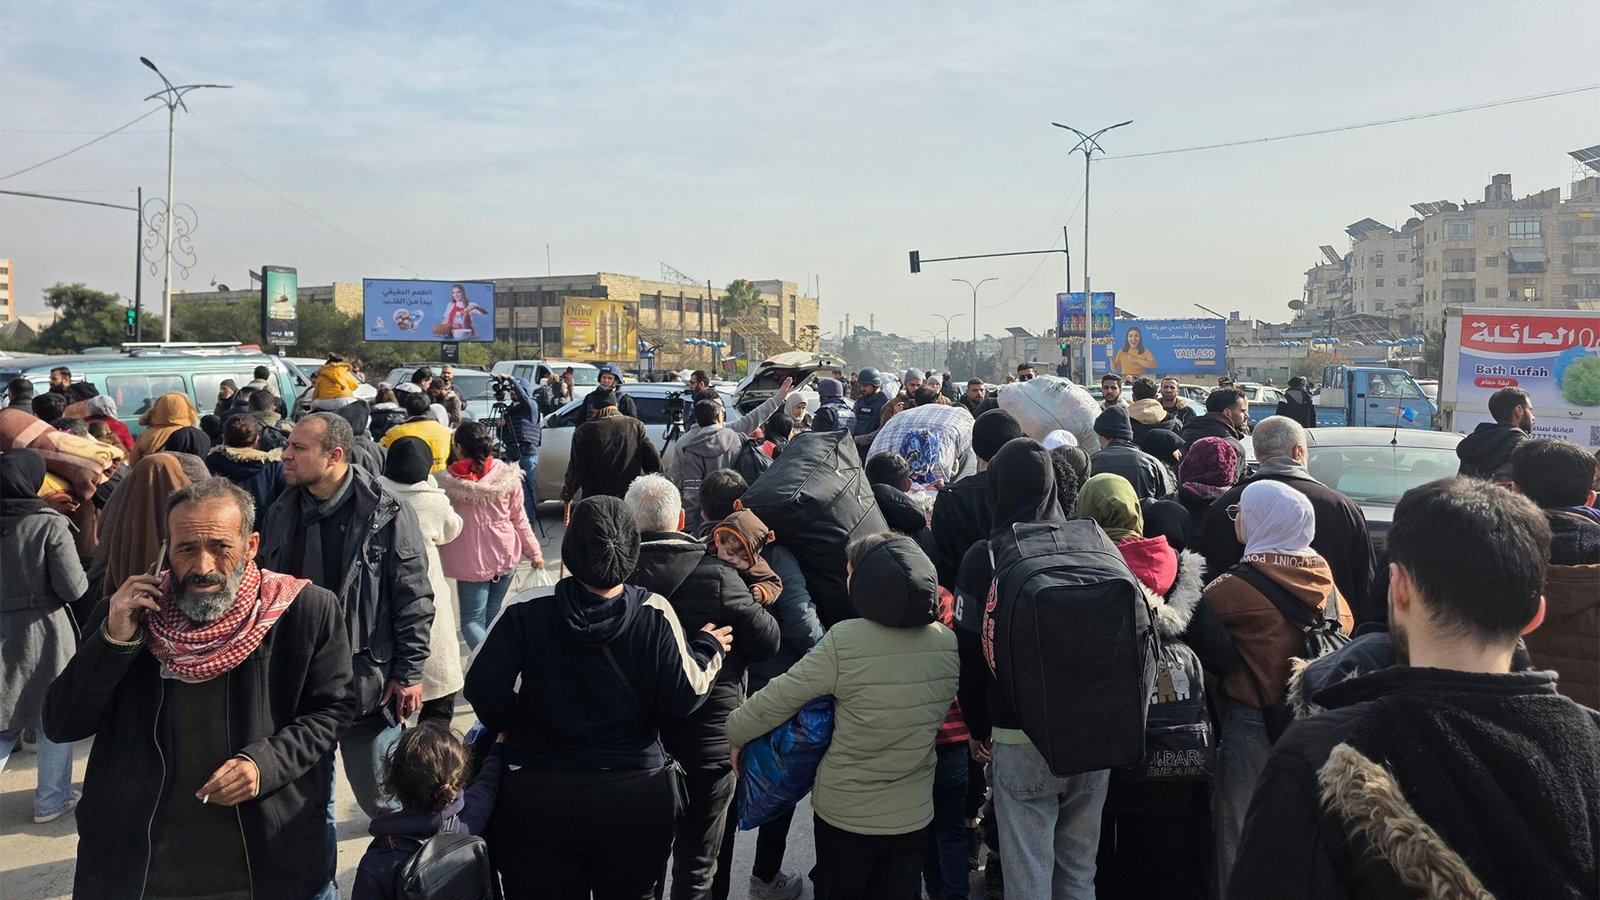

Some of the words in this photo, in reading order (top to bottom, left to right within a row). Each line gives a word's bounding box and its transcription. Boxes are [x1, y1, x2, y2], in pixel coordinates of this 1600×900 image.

[382, 287, 410, 297] الحقيقي
[411, 288, 433, 297] الطعم
[566, 303, 593, 316] Oliva
[1470, 321, 1575, 346] العائلة
[1174, 348, 1216, 359] YALLA50
[1475, 364, 1506, 375] Bath
[1510, 365, 1549, 377] Lufah
[1273, 555, 1304, 568] POINT
